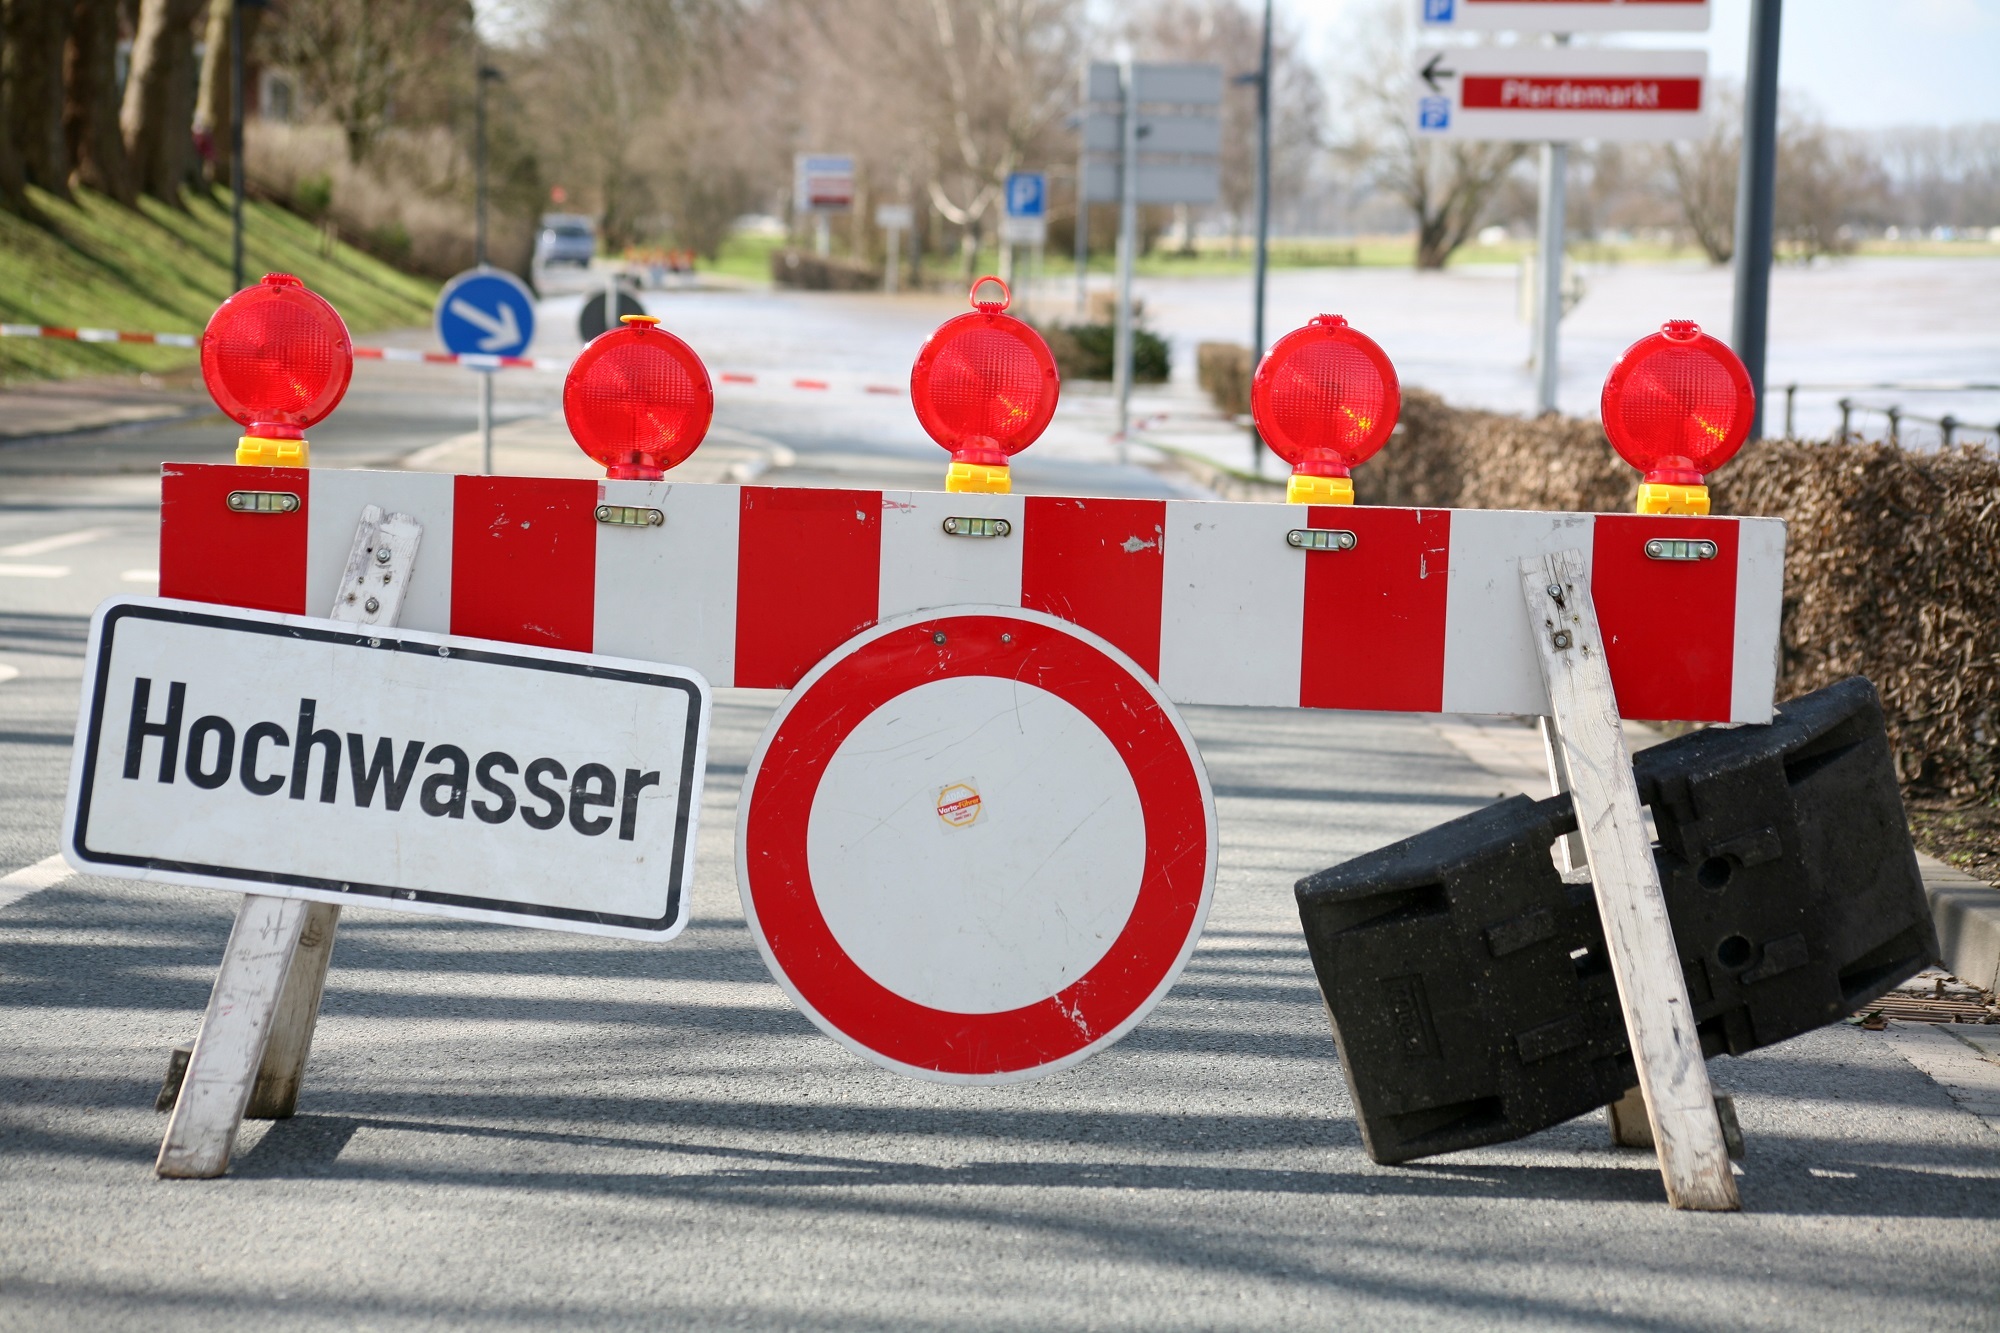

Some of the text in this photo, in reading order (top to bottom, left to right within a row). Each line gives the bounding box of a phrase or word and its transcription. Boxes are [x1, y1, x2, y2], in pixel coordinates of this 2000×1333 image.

[1501, 80, 1658, 106] Pferdemarkt
[1011, 177, 1037, 211] P
[122, 676, 661, 842] Hochwasser
